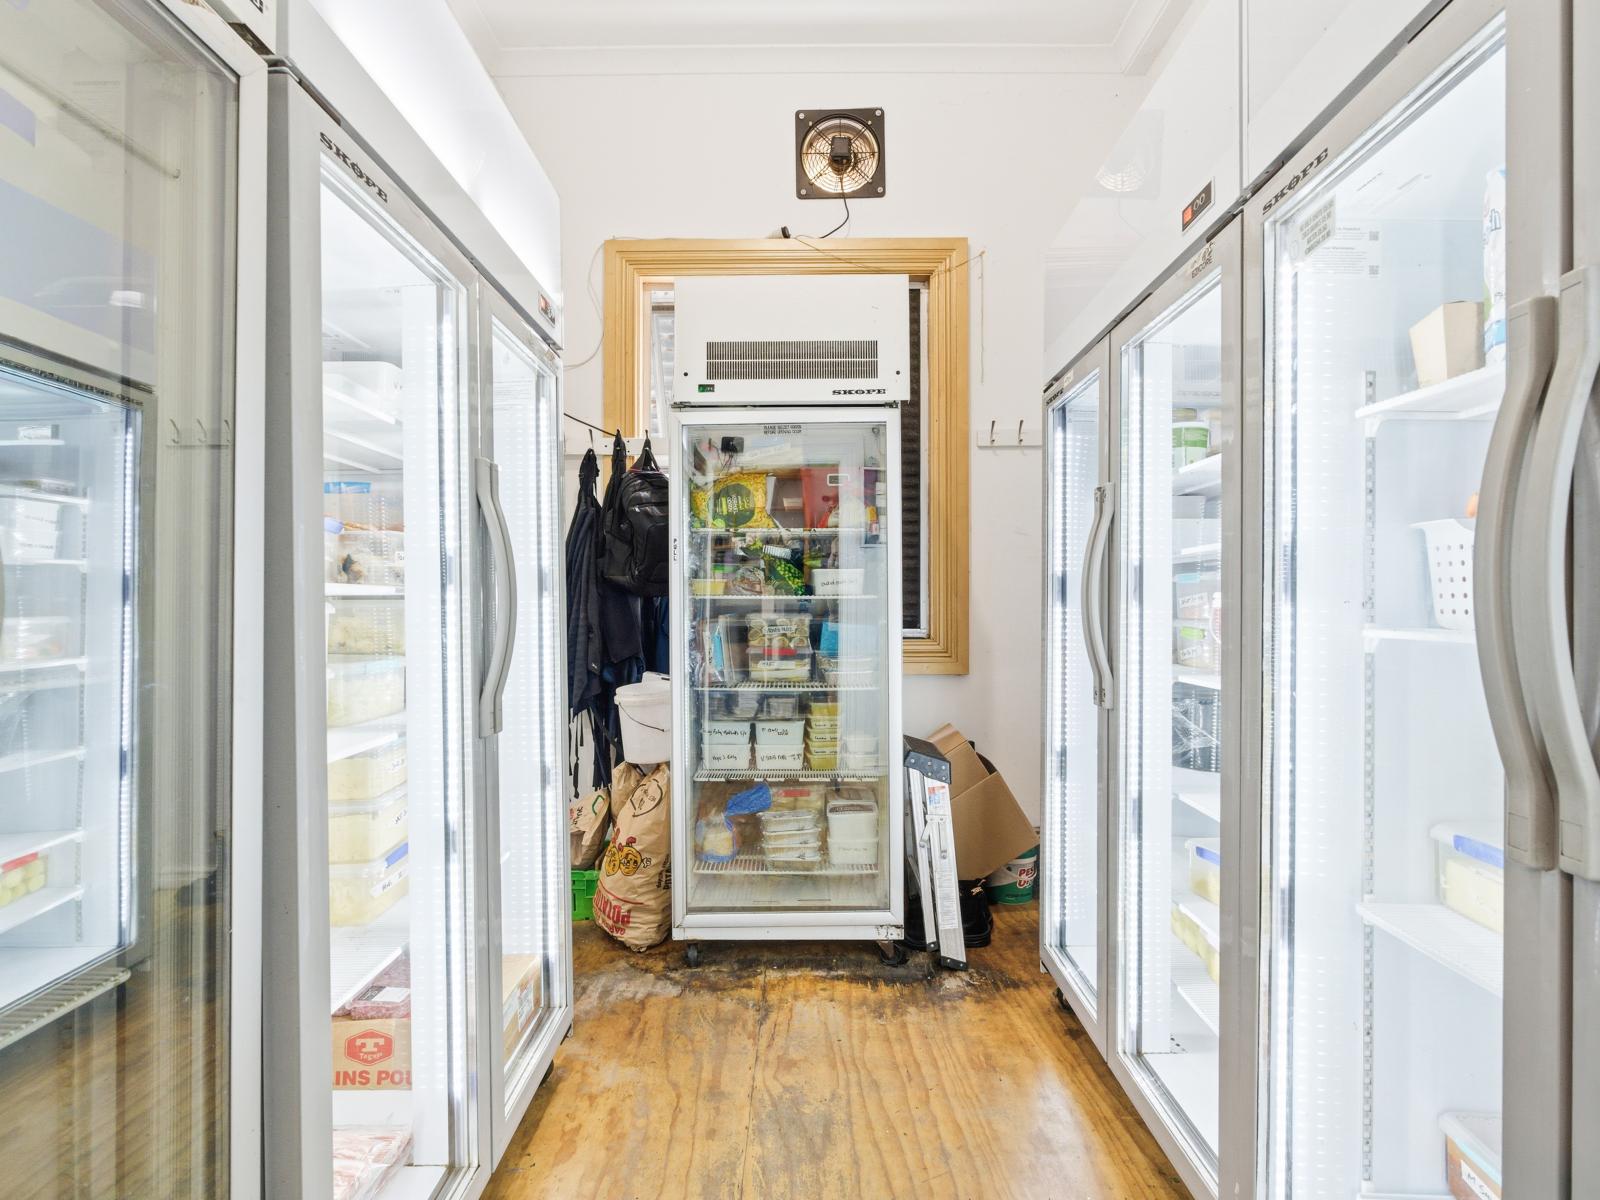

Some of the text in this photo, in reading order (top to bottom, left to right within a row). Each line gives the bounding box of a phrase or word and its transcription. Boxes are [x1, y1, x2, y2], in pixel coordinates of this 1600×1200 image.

[319, 131, 389, 204] SKOPE
[1262, 147, 1329, 216] SKOPE
[334, 1070, 370, 1086] INS
